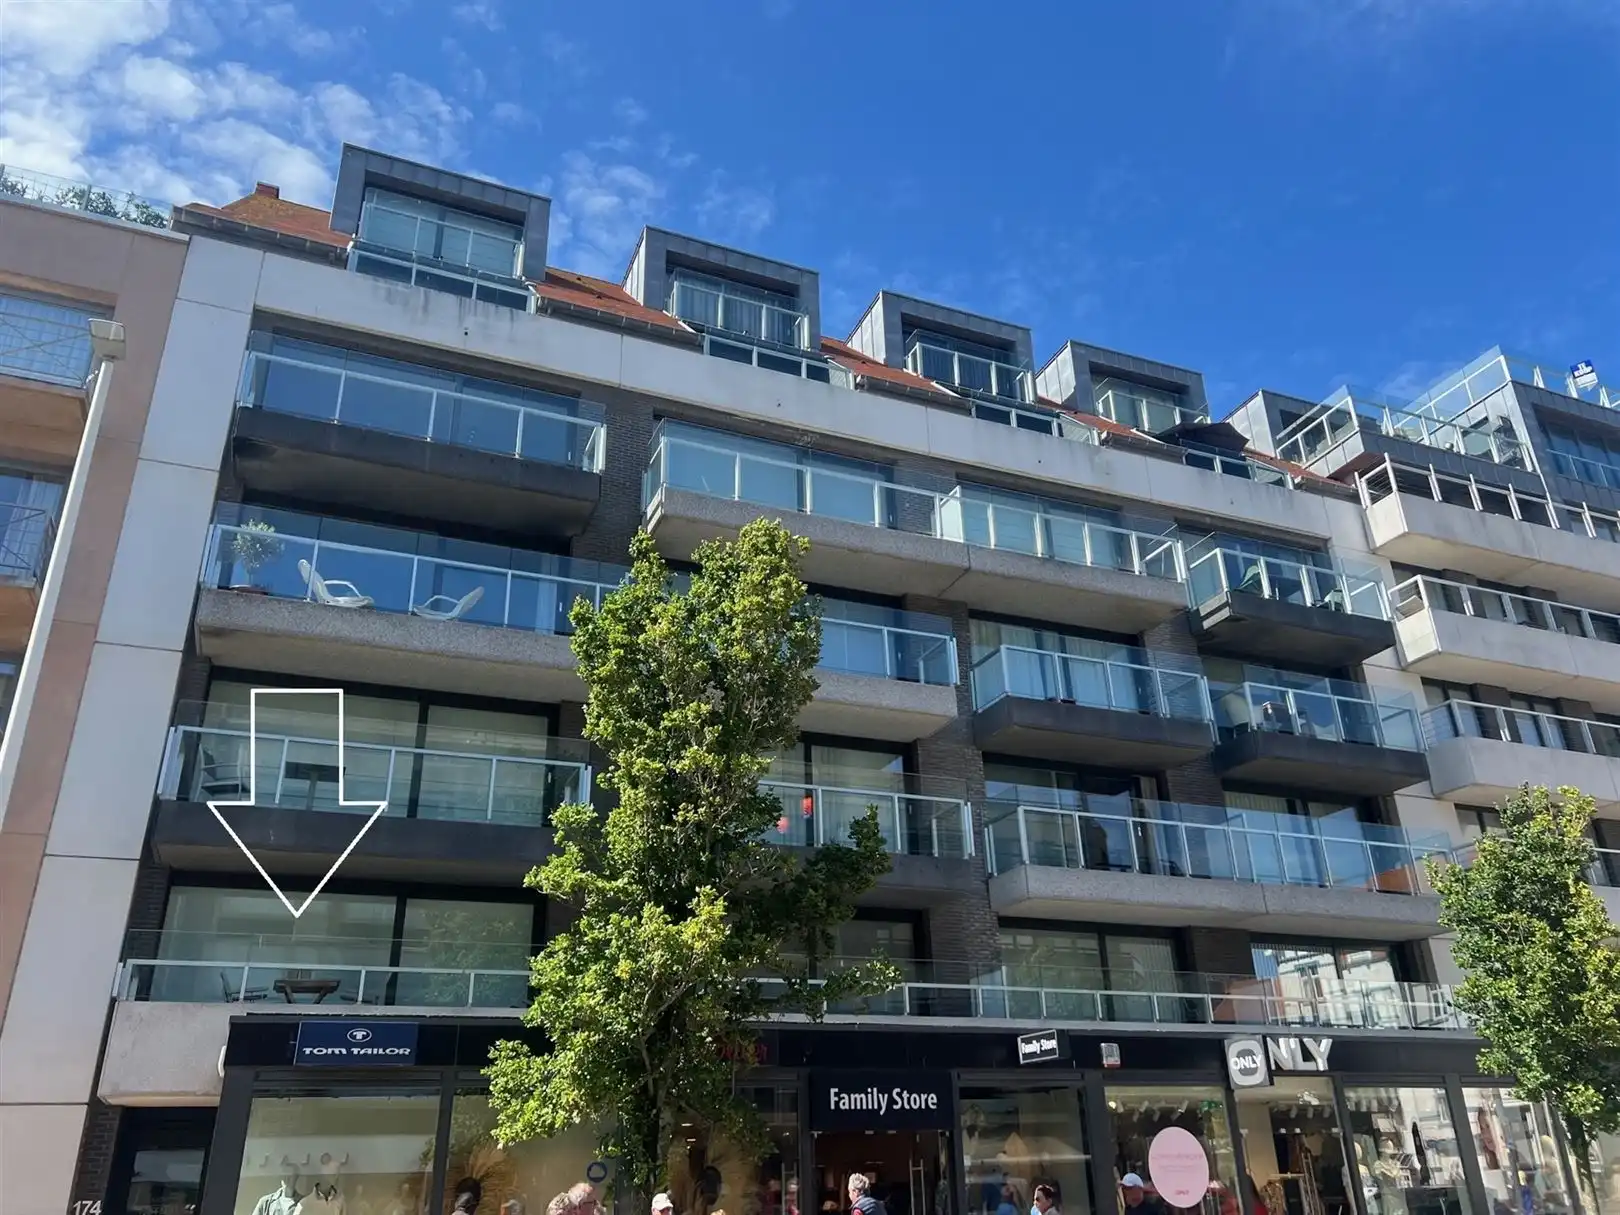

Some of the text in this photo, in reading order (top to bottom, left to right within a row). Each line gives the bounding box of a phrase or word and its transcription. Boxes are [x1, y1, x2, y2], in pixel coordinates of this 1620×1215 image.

[302, 1047, 411, 1056] TOM TAILOR
[1021, 1038, 1057, 1055] Family Store
[1230, 1054, 1262, 1070] ONLY
[829, 1087, 938, 1116] Family Store
[72, 1199, 102, 1215] 174
